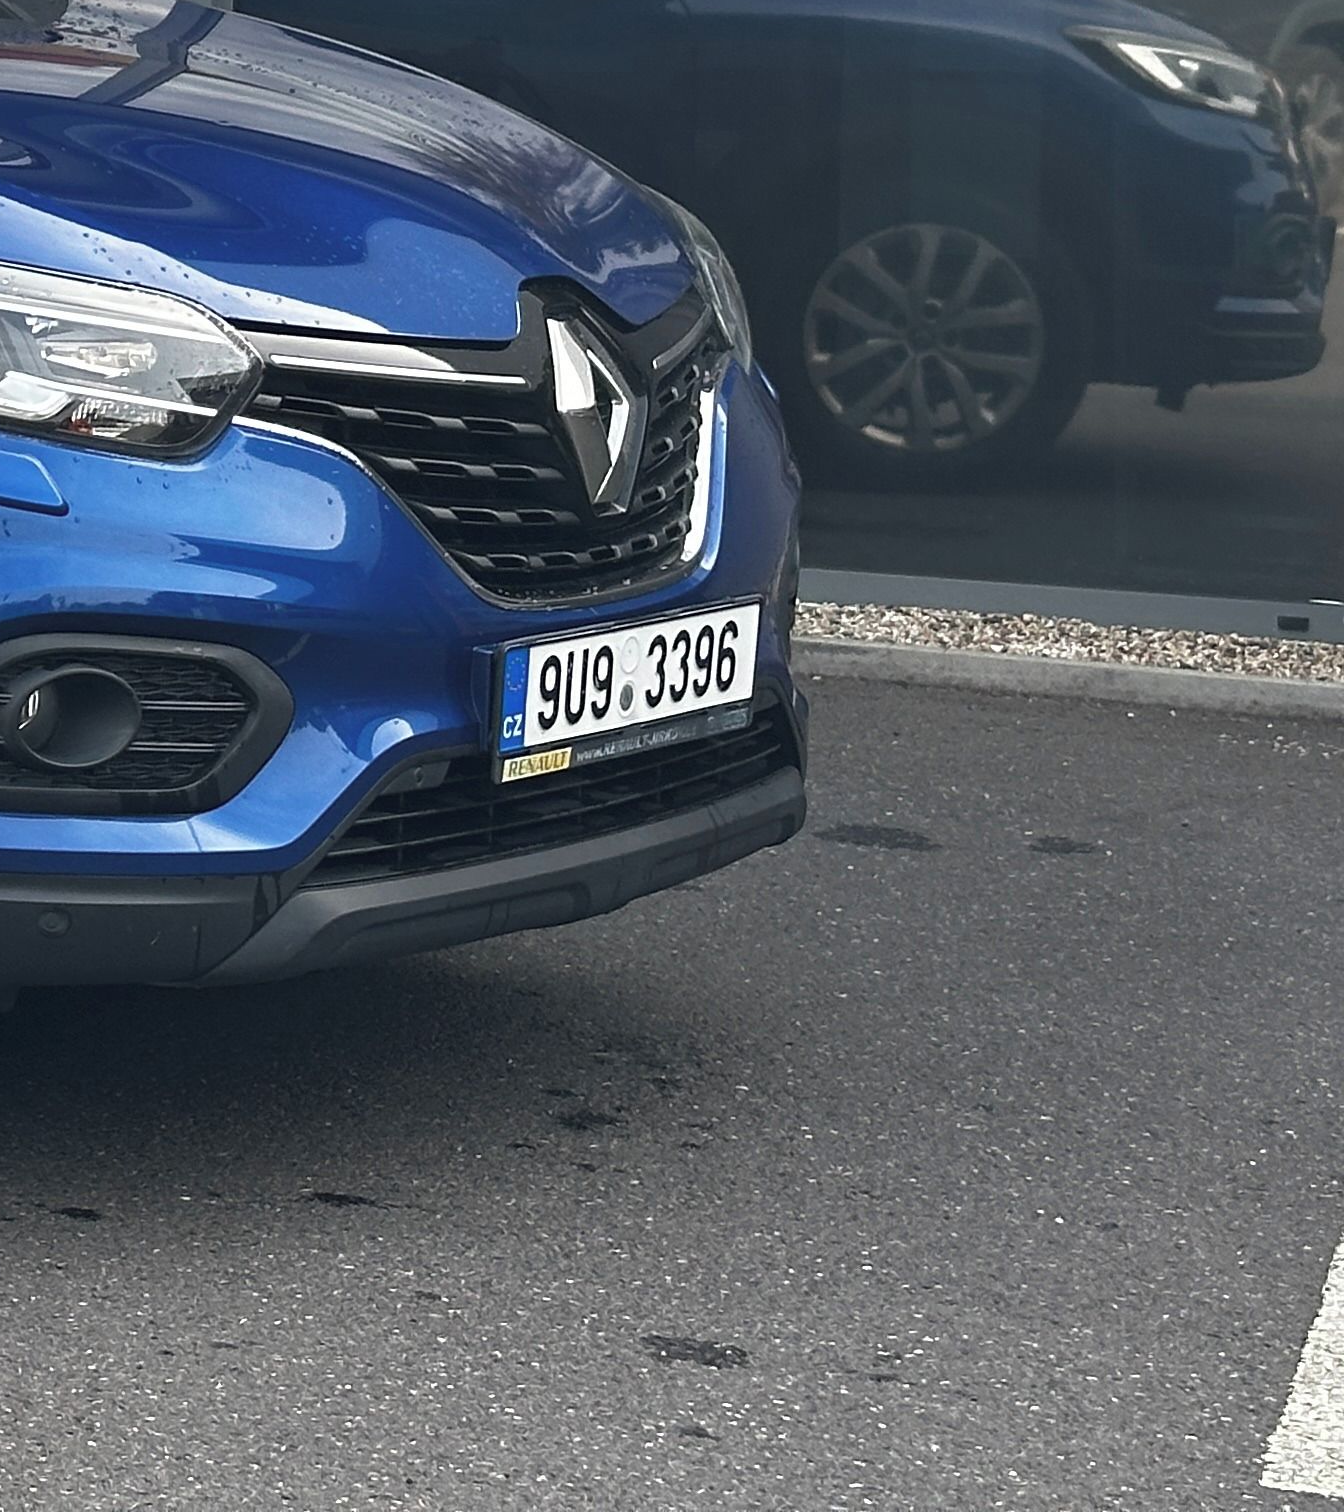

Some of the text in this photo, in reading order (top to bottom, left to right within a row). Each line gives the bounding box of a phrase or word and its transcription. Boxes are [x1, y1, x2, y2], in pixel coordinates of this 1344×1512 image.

[537, 619, 739, 731] 9U9 3396
[503, 713, 523, 739] CZ
[507, 750, 569, 778] RENAULT
